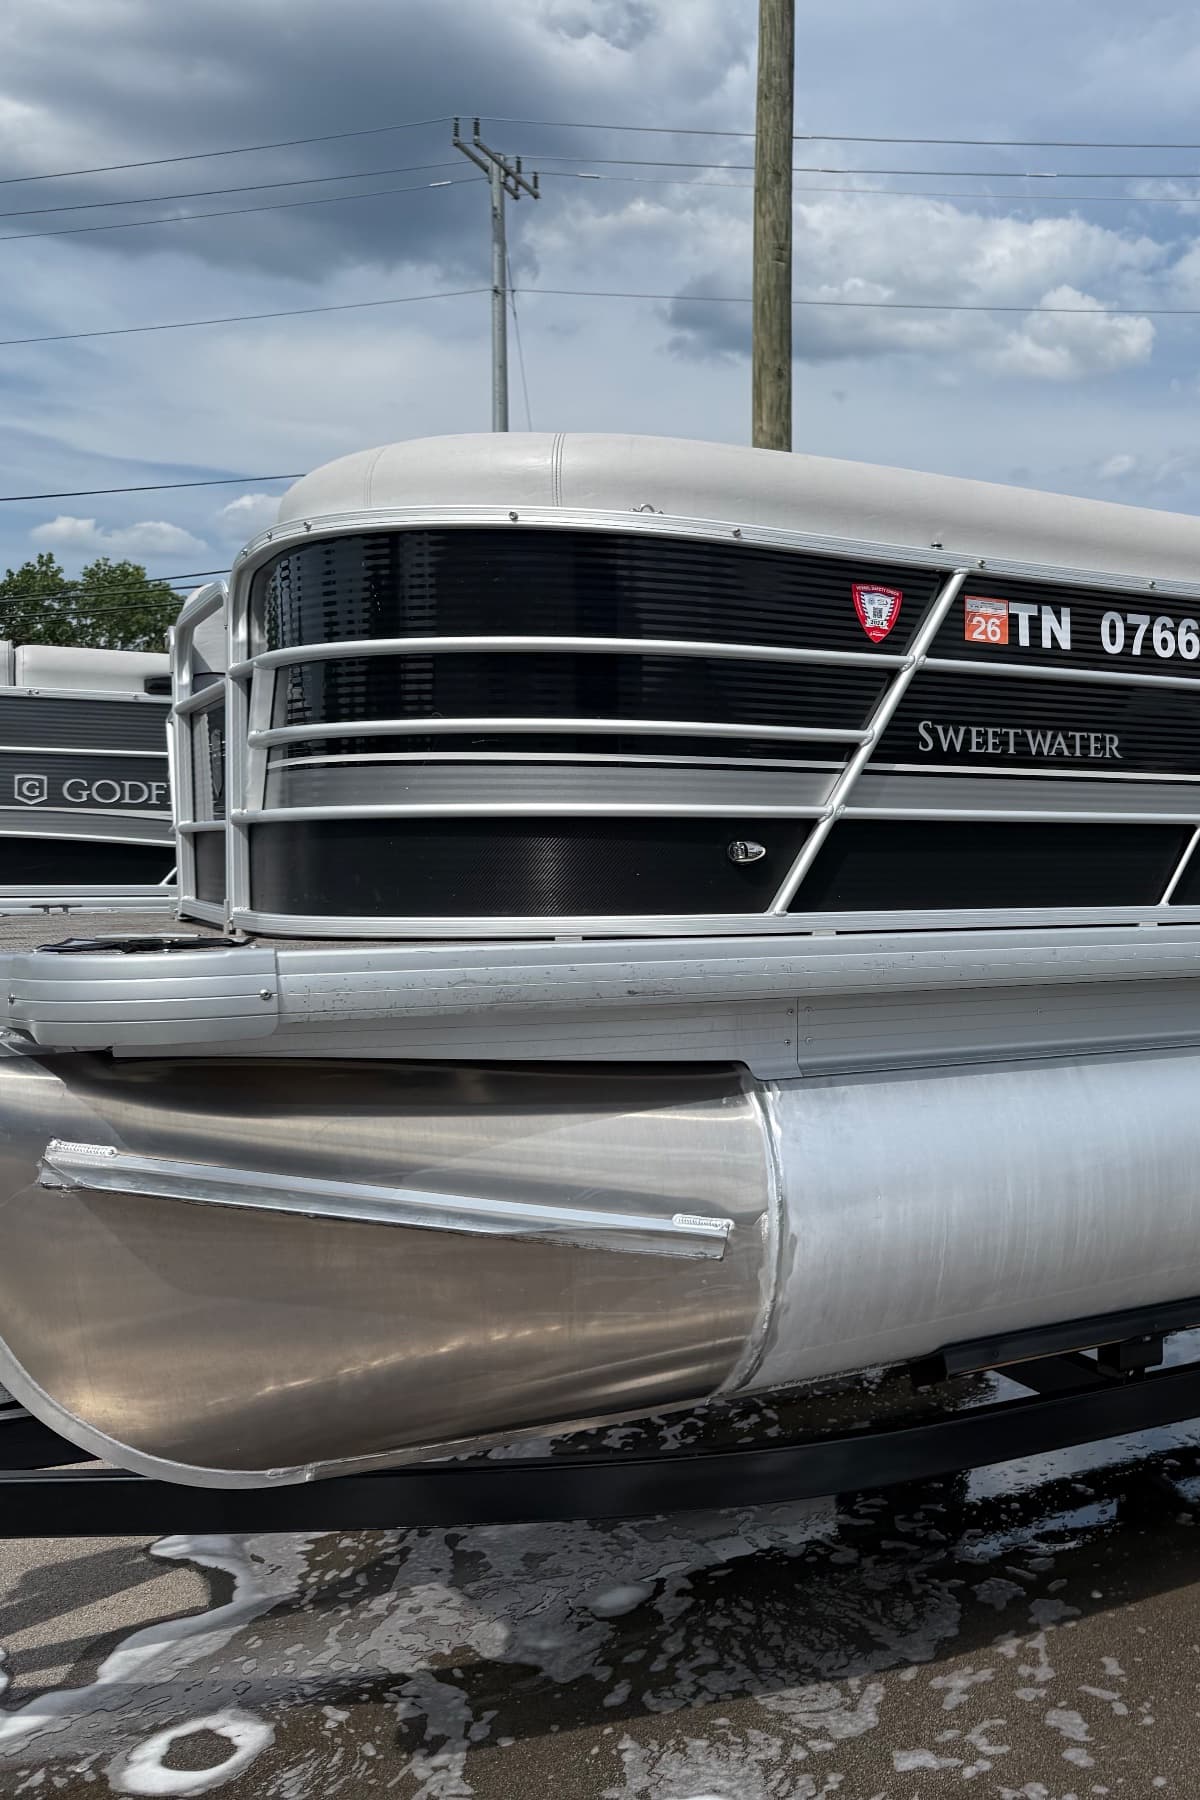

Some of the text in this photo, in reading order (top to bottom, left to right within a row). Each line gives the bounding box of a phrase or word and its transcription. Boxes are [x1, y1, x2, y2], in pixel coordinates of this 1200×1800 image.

[971, 616, 1001, 641] 26
[1008, 602, 1071, 650] TN
[1101, 611, 1200, 659] 0766
[62, 778, 172, 805] GODF
